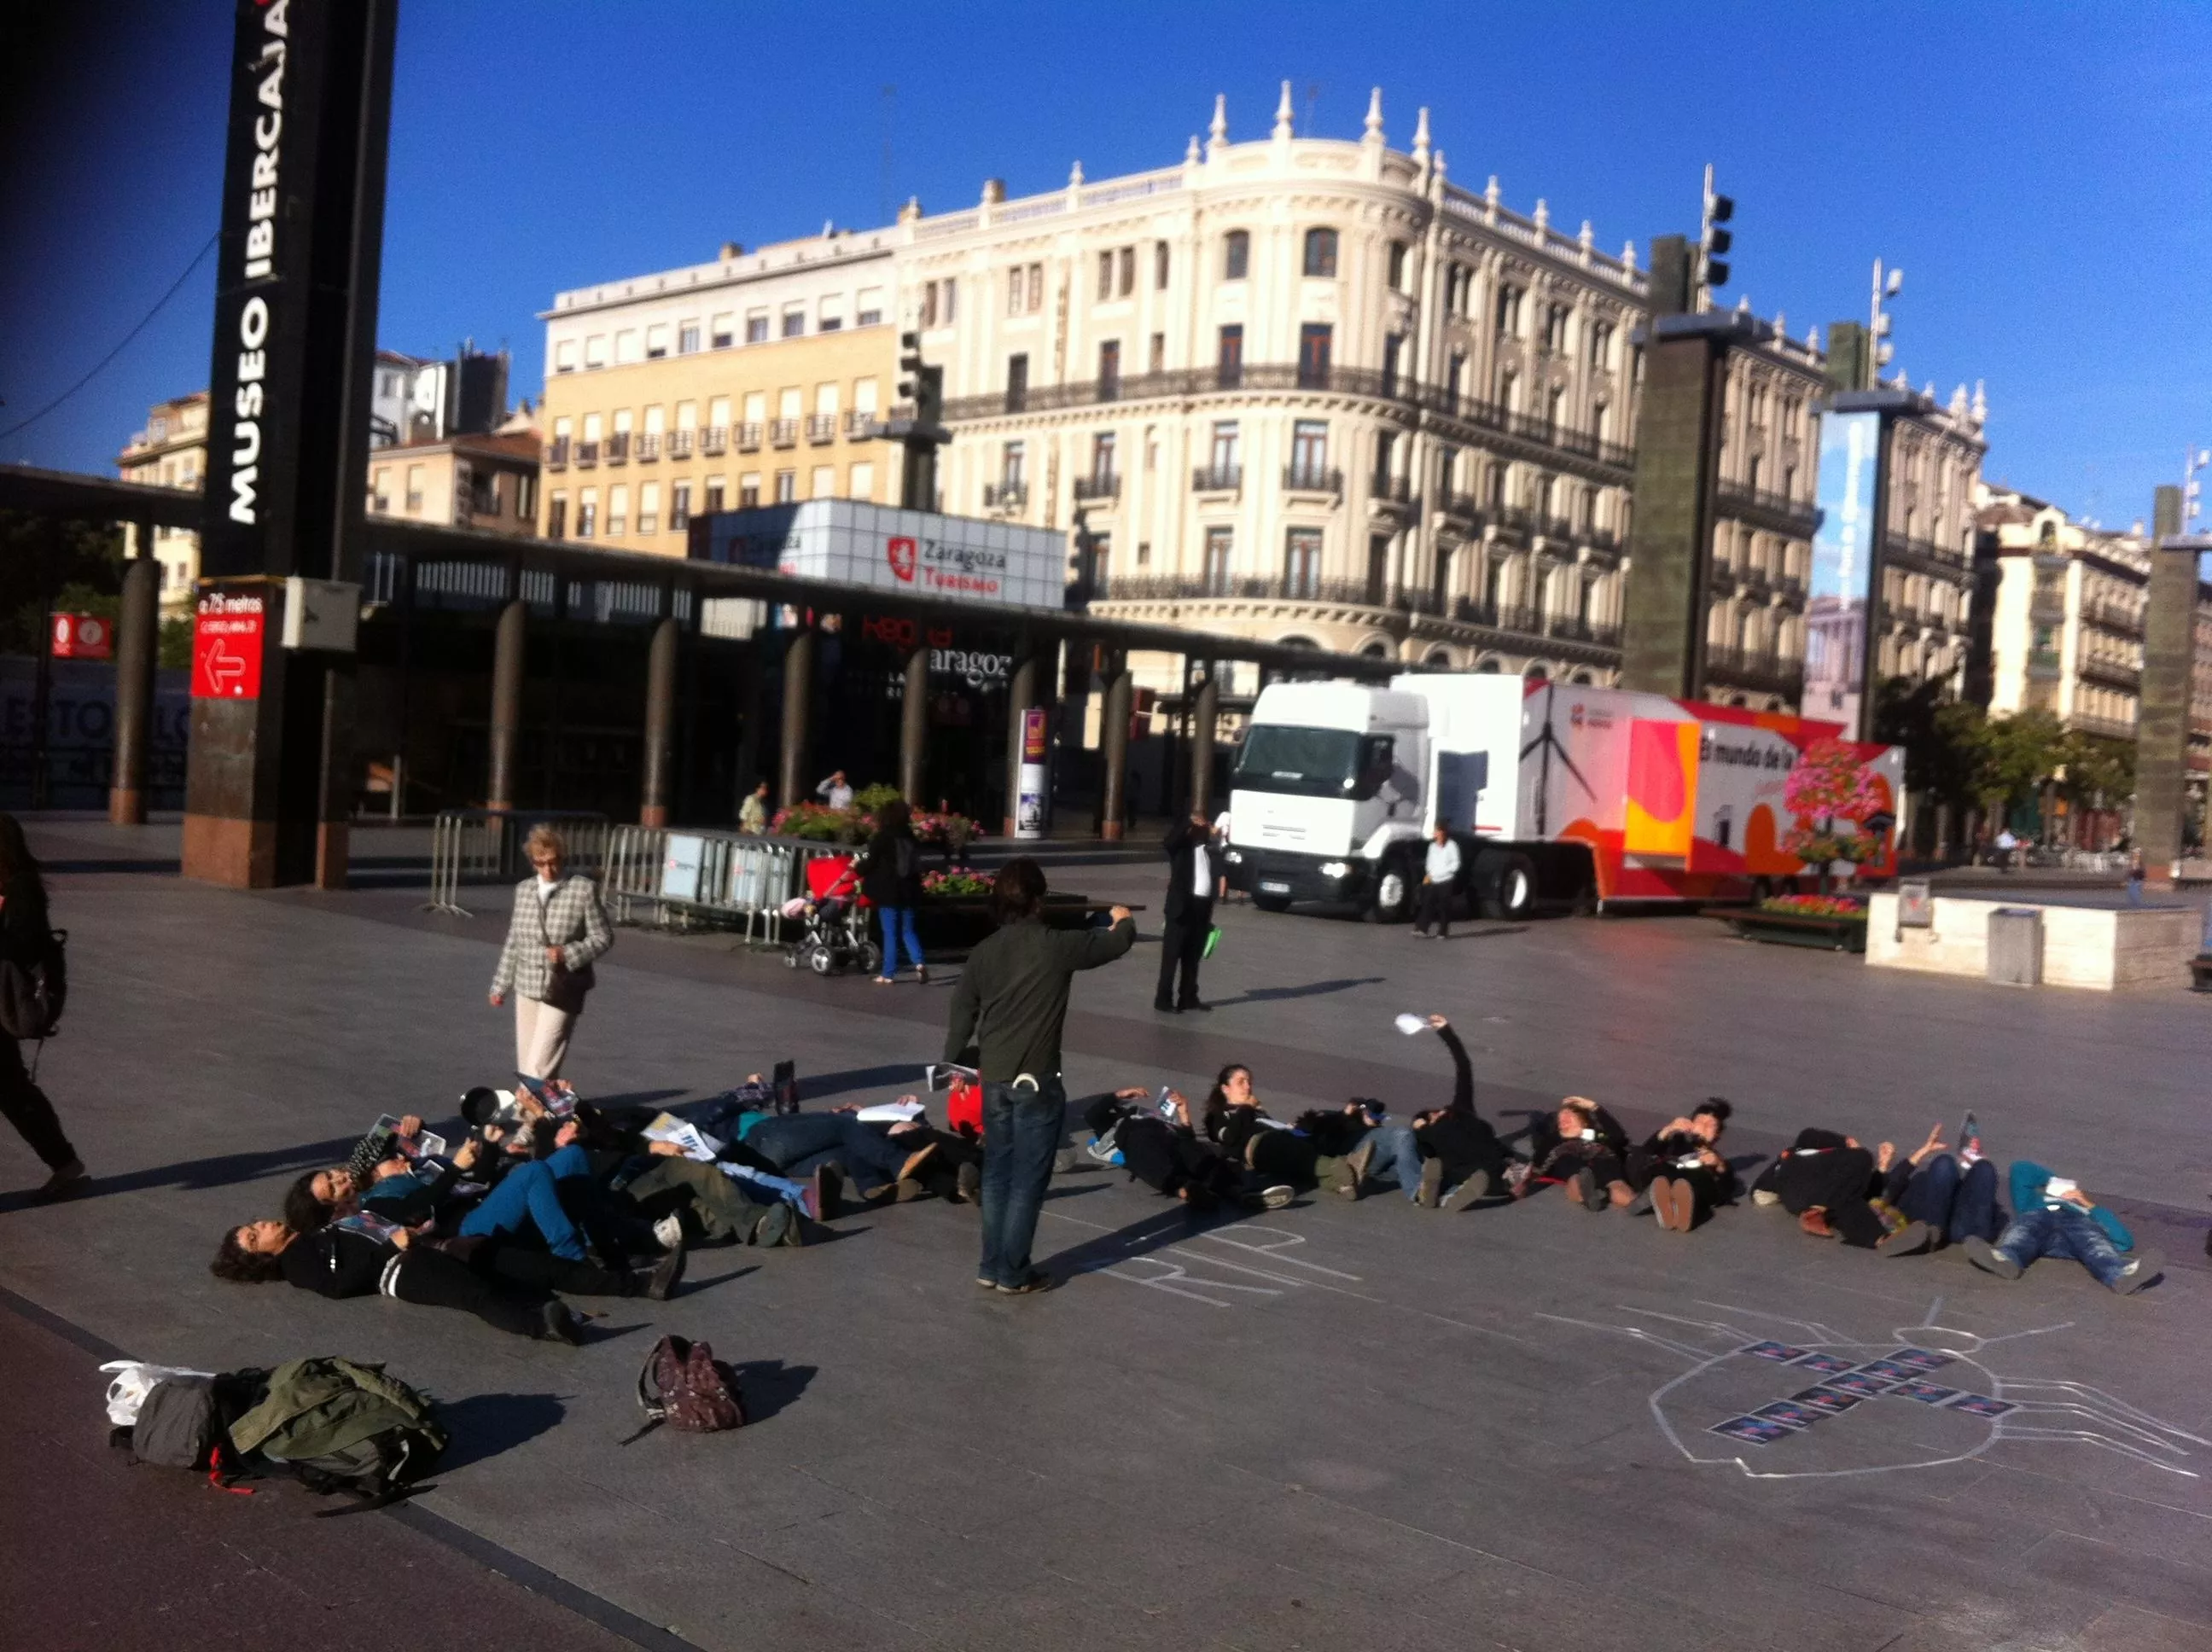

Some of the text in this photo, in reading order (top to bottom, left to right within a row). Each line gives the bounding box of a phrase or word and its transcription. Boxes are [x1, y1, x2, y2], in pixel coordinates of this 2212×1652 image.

[228, 0, 289, 525] MUSEO IBERCAJA
[924, 539, 1006, 572] Zaragoza
[1715, 740, 1761, 767] mundo
[1764, 743, 1779, 770] de
